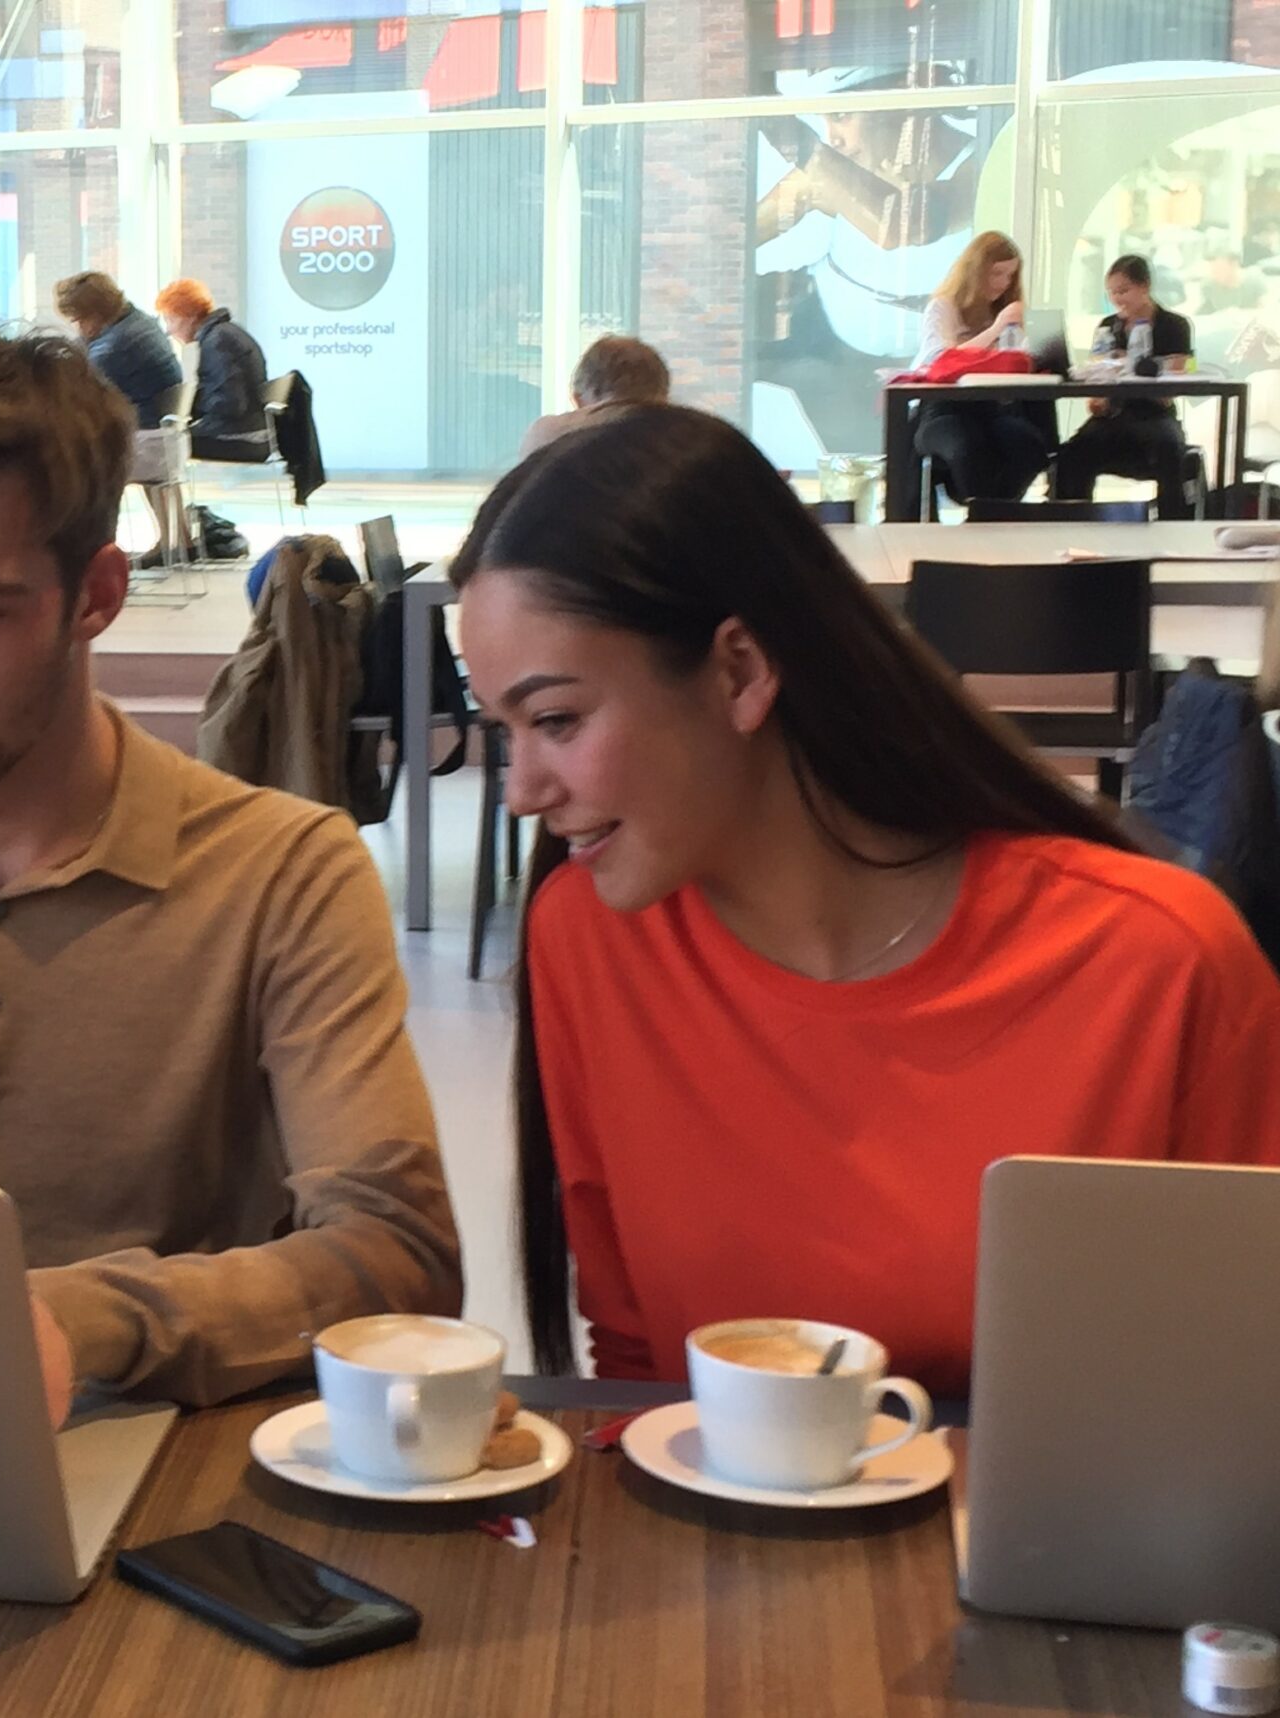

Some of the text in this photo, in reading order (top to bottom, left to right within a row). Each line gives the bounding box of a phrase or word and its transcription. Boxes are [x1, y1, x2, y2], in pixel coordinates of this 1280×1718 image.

[291, 225, 383, 247] SPORT
[298, 251, 375, 273] 2000
[280, 322, 395, 339] your professional
[305, 342, 373, 357] sportshop
